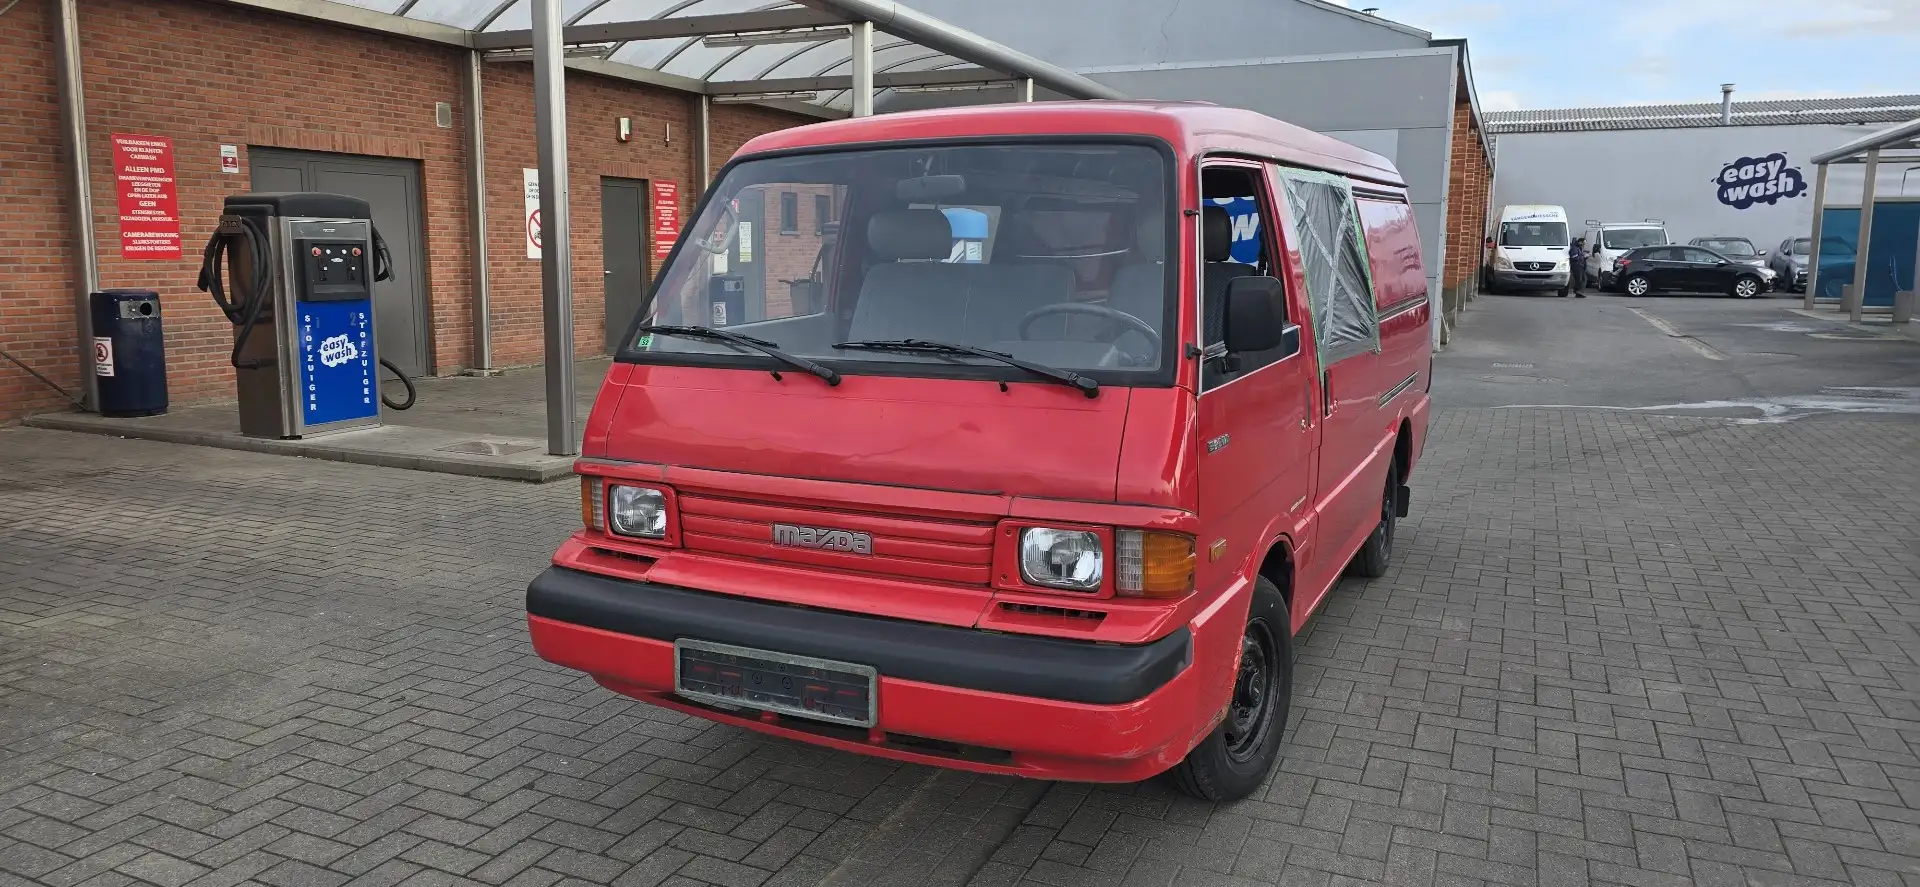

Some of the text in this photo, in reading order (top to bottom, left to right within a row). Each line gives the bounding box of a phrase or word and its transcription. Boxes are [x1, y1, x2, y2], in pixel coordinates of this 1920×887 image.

[130, 153, 157, 161] CARWASH
[125, 165, 150, 173] ALLEEN
[1723, 159, 1782, 183] easy
[1727, 172, 1794, 202] wash
[322, 338, 346, 352] easy
[325, 345, 352, 363] wash
[304, 314, 317, 411] STOFZUIGER
[358, 312, 371, 404] STOFZUIGER
